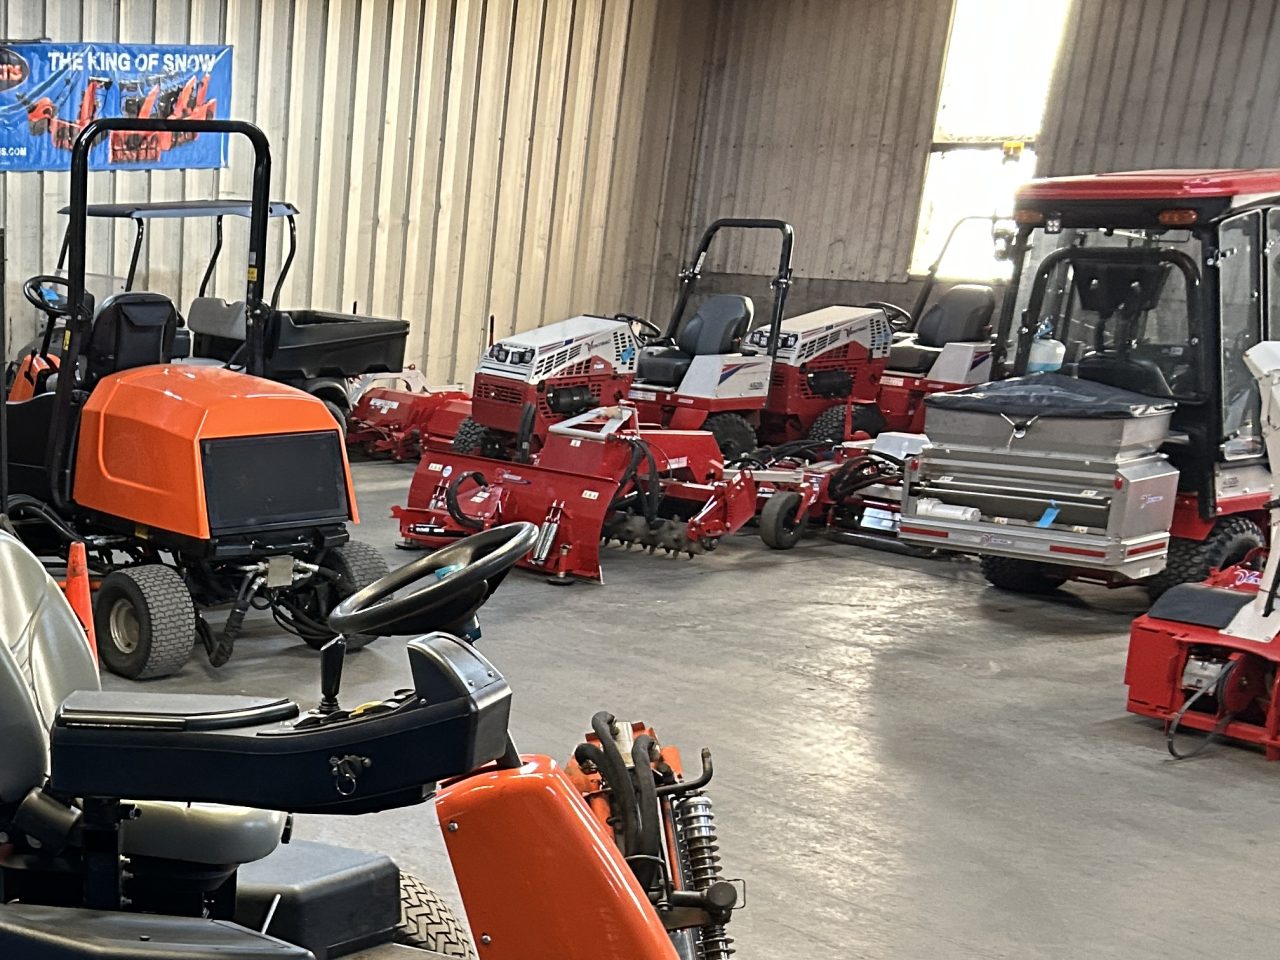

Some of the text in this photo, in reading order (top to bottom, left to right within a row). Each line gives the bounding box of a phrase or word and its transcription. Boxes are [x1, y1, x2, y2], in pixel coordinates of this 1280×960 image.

[47, 51, 216, 73] THE KING OF SNOW
